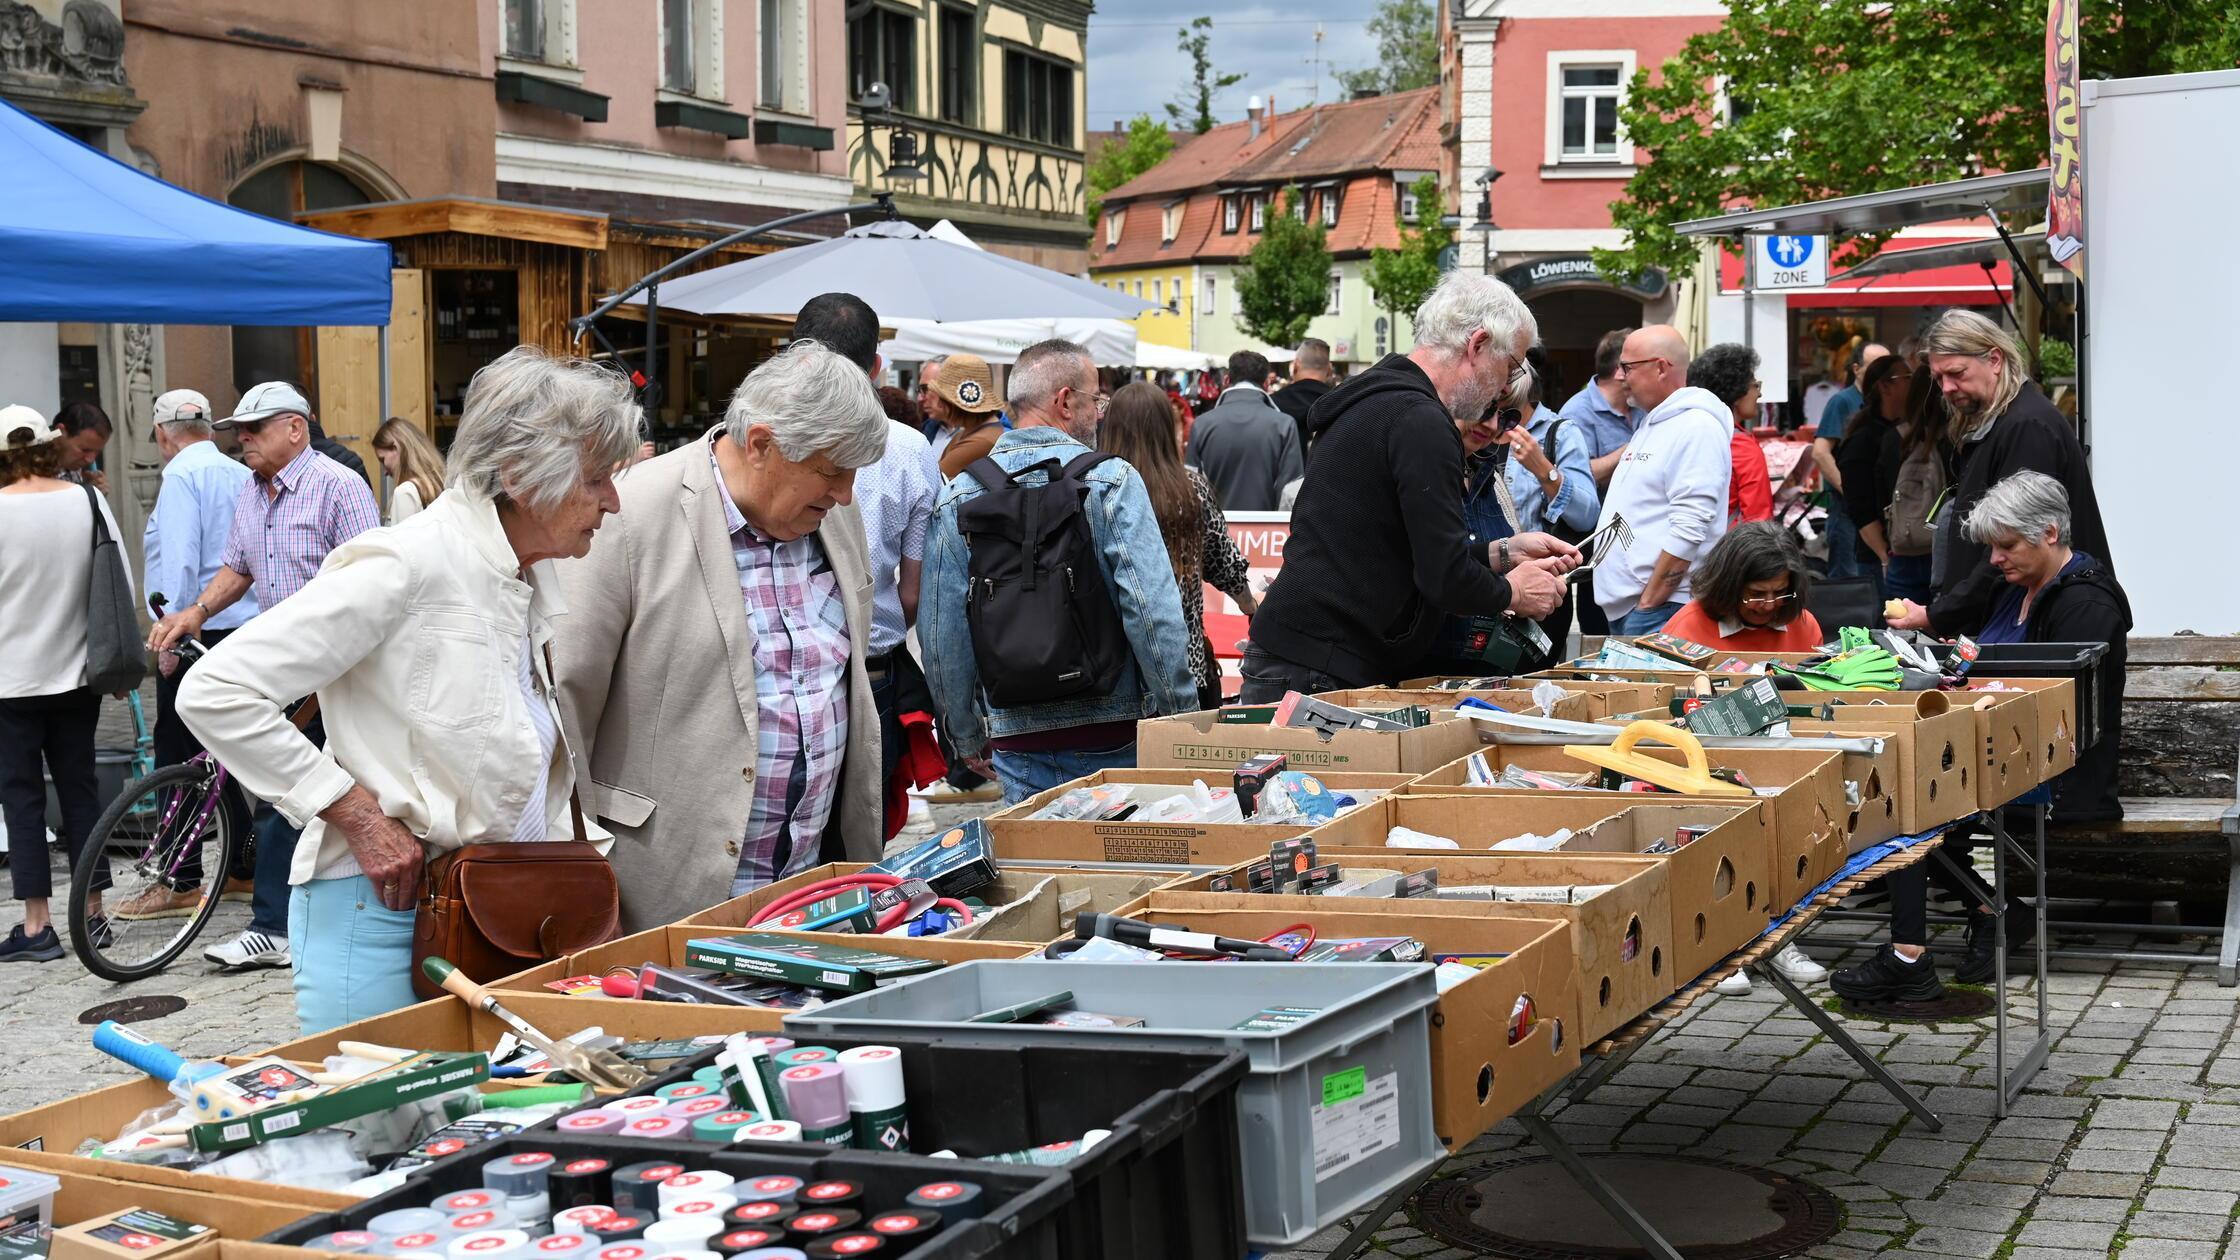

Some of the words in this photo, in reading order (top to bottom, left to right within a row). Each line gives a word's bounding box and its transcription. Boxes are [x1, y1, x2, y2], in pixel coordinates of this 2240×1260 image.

[1530, 260, 1612, 280] LÖWENKE
[1773, 270, 1809, 285] ZONE
[1190, 748, 1195, 756] 2
[1202, 749, 1207, 757] 3
[1292, 753, 1301, 761] 10
[1305, 754, 1314, 762] 11
[1318, 754, 1328, 762] 12
[698, 954, 727, 966] PARKSIDE
[734, 956, 778, 968] Magnetischer
[734, 961, 785, 974] Werkzeughalter
[441, 1067, 474, 1084] PARKSIDE
